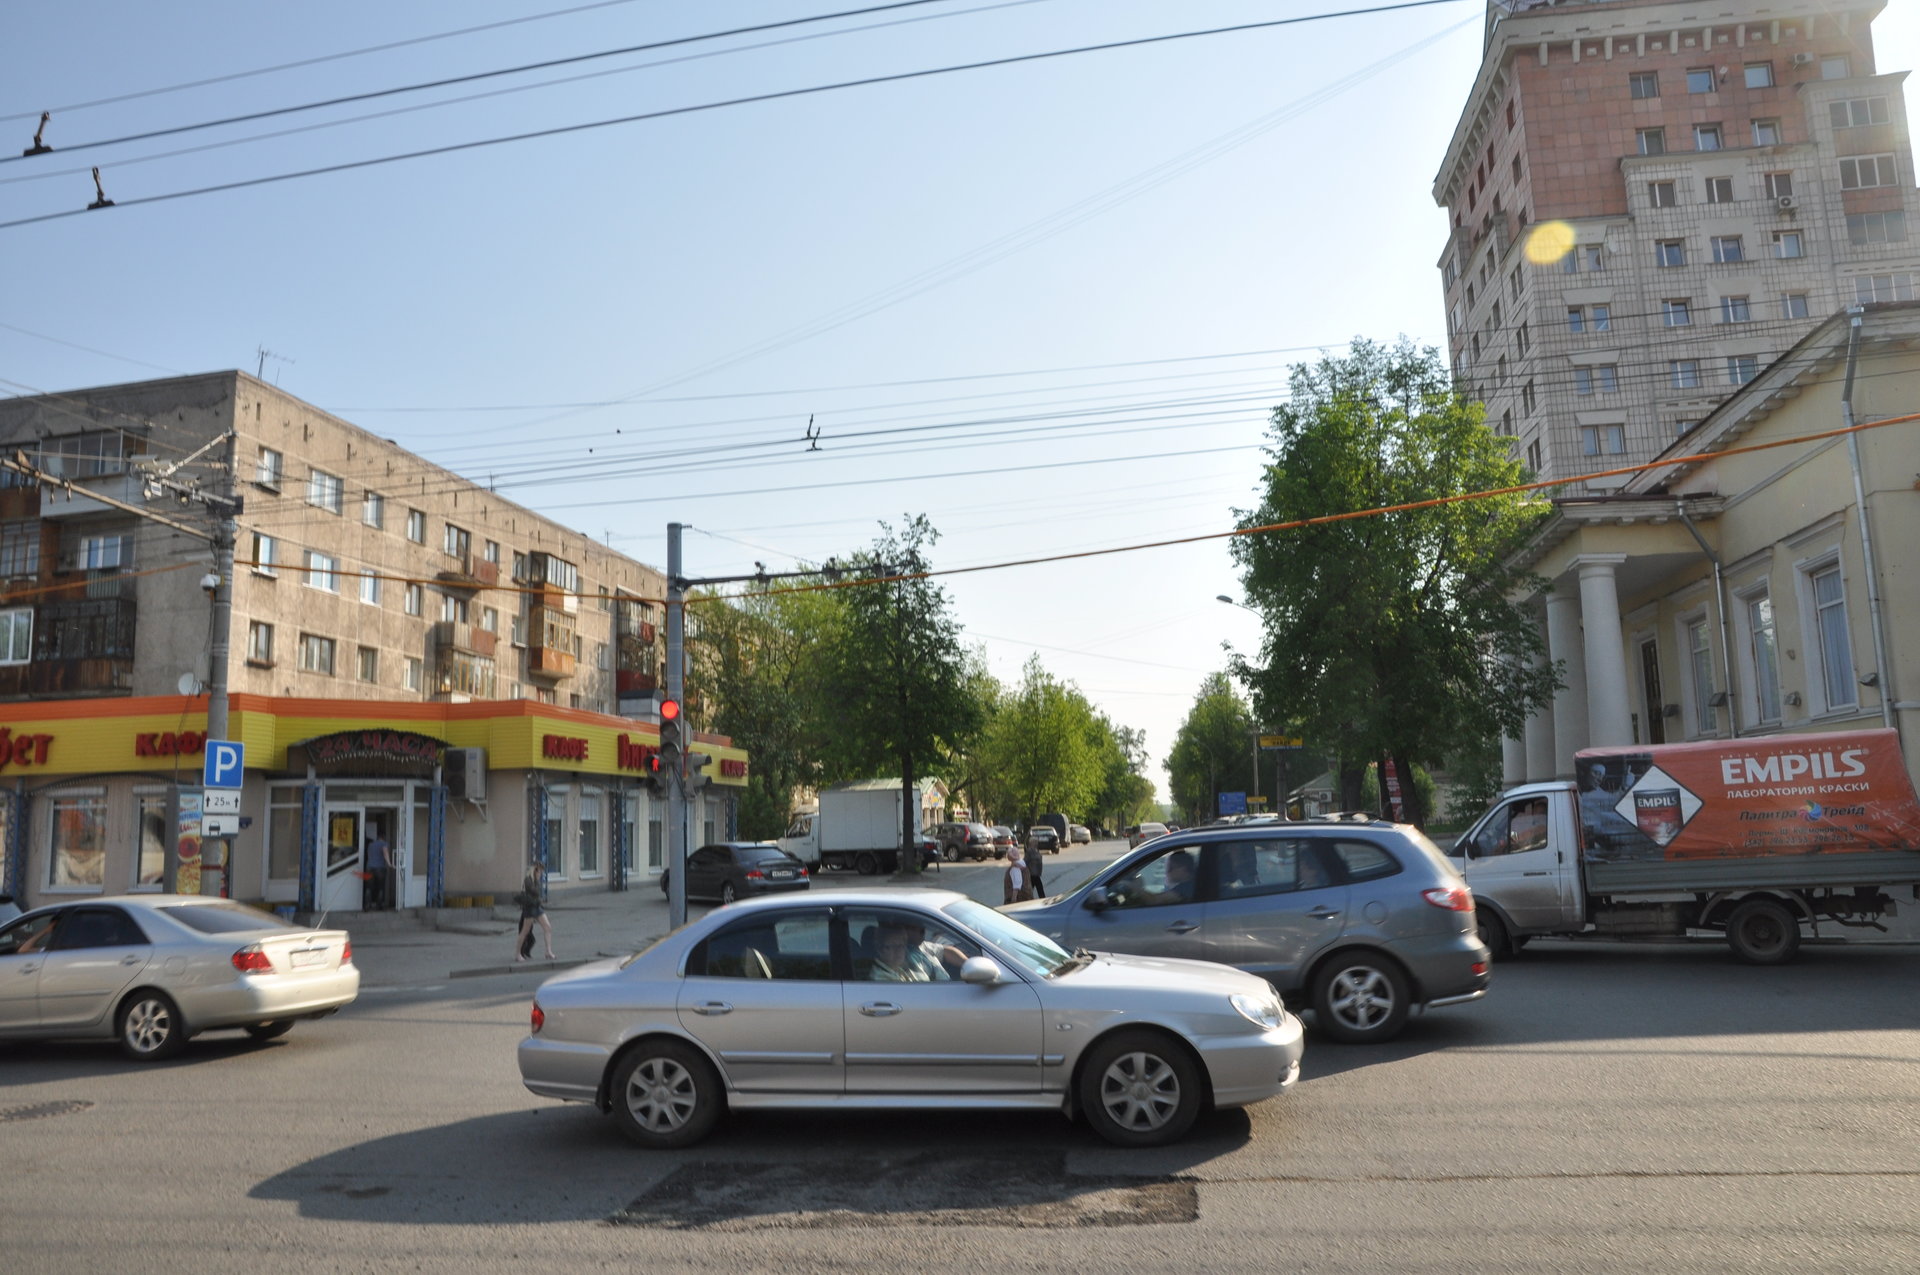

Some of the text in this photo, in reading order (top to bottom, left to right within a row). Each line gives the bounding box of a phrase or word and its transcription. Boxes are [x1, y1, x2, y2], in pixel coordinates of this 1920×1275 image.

[362, 731, 438, 760] ЧАСА
[543, 734, 589, 761] КАФЕ
[215, 745, 237, 783] P
[721, 759, 747, 777] КАФЕ
[1721, 749, 1866, 785] EMPILS
[1726, 782, 1870, 799] ЛАБОРАТОРИЯ КРАСКИ
[1637, 796, 1678, 808] EMPILS
[1739, 805, 1865, 821] Палитра Трейд
